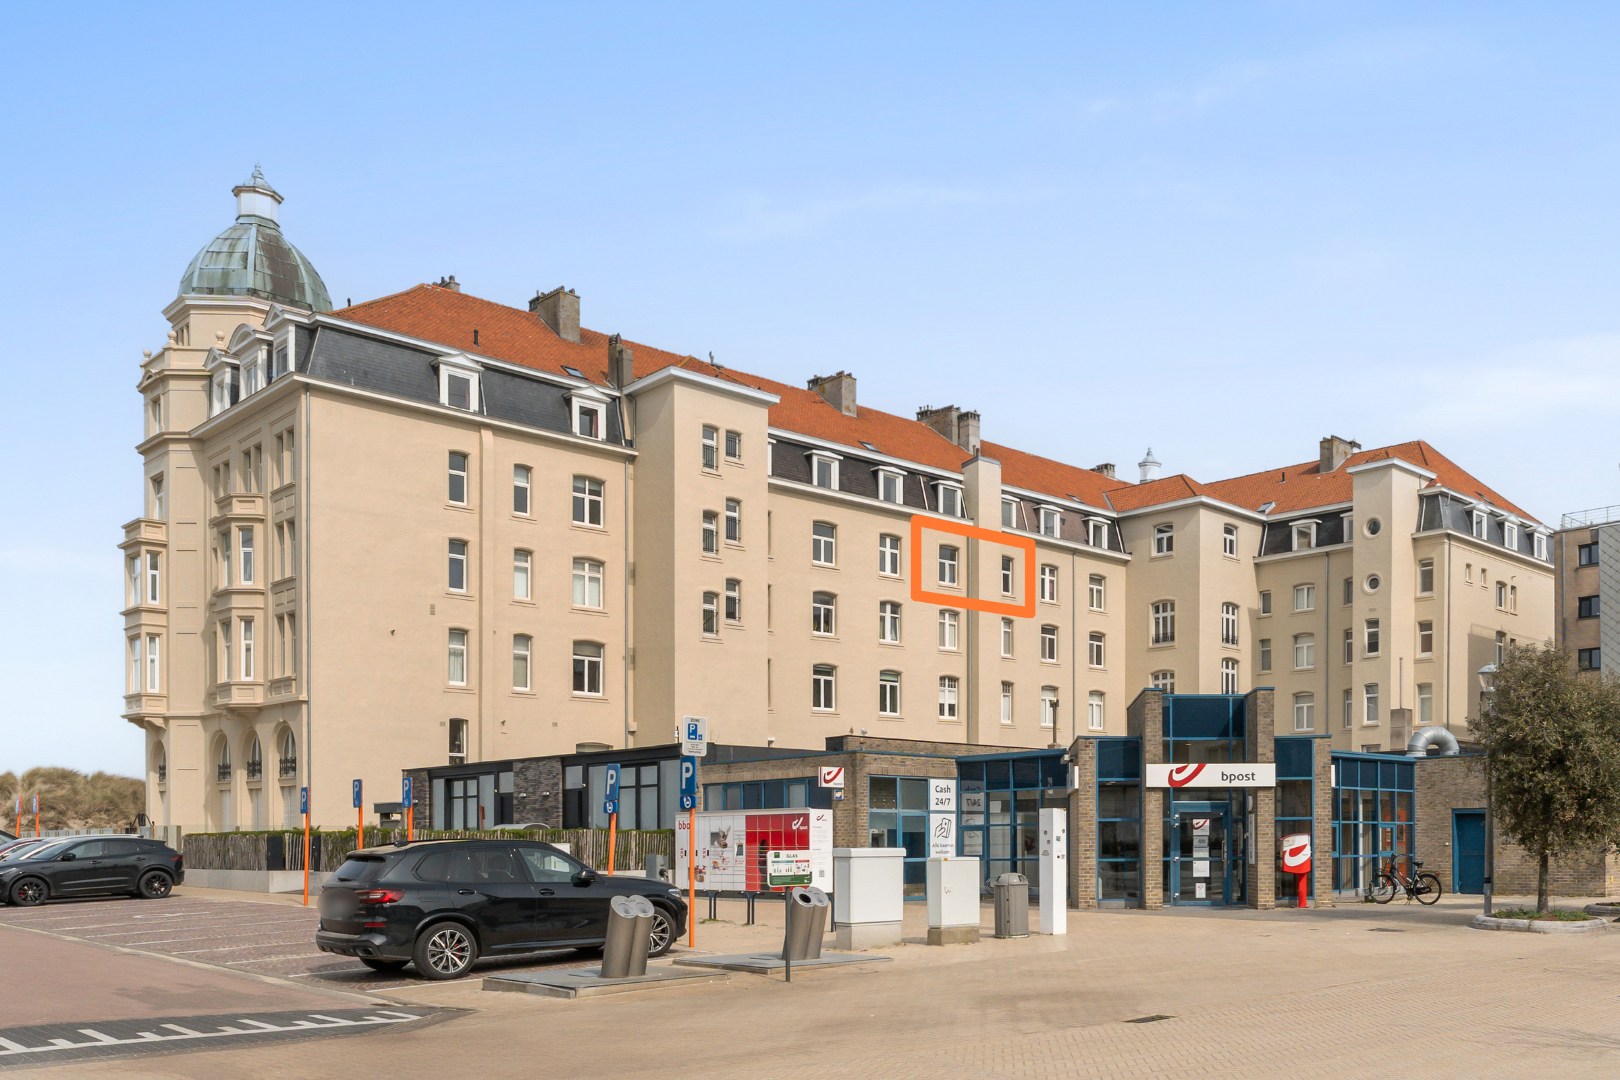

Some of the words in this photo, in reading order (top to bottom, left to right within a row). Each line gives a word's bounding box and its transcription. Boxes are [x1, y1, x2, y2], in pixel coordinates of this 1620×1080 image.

[689, 724, 696, 733] P
[606, 769, 616, 795] P
[682, 762, 693, 789] P
[1221, 771, 1256, 784] bpost
[354, 781, 360, 798] P
[403, 779, 409, 798] P
[935, 785, 951, 793] Cash
[301, 791, 307, 810] P
[935, 798, 951, 806] 24/7
[679, 820, 691, 830] bbo
